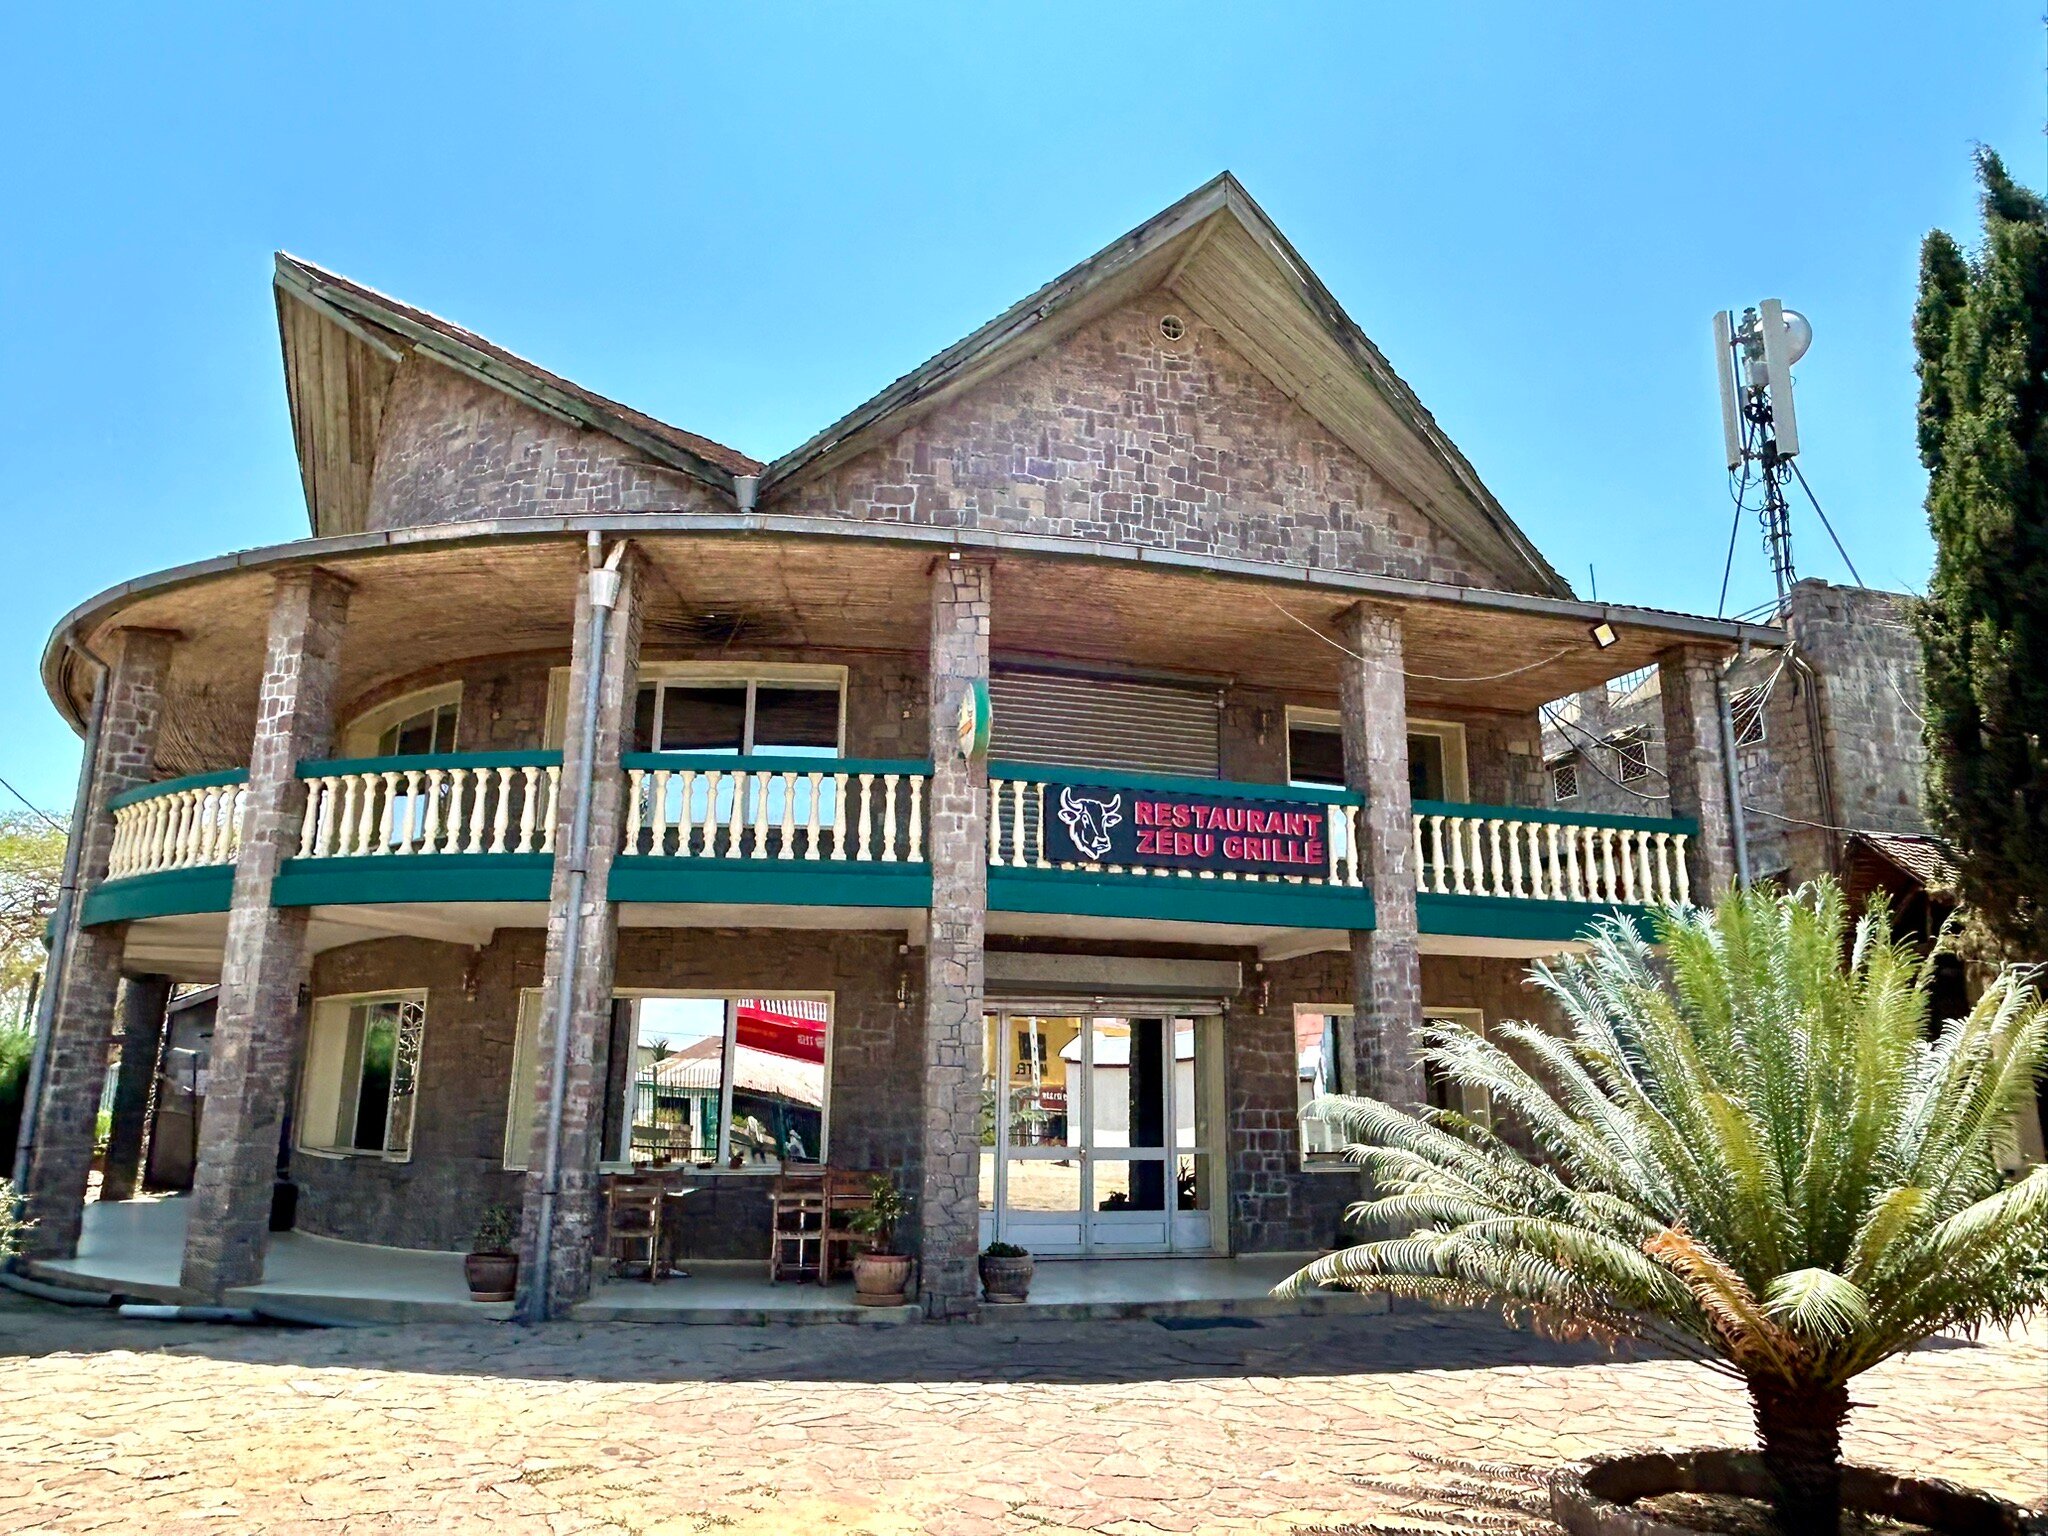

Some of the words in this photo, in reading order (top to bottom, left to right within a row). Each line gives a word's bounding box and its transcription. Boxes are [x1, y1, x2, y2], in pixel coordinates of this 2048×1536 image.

[1134, 801, 1322, 837] RESTAURANT
[1136, 828, 1215, 857] ZÉBU
[1223, 837, 1322, 864] GRILLÉ
